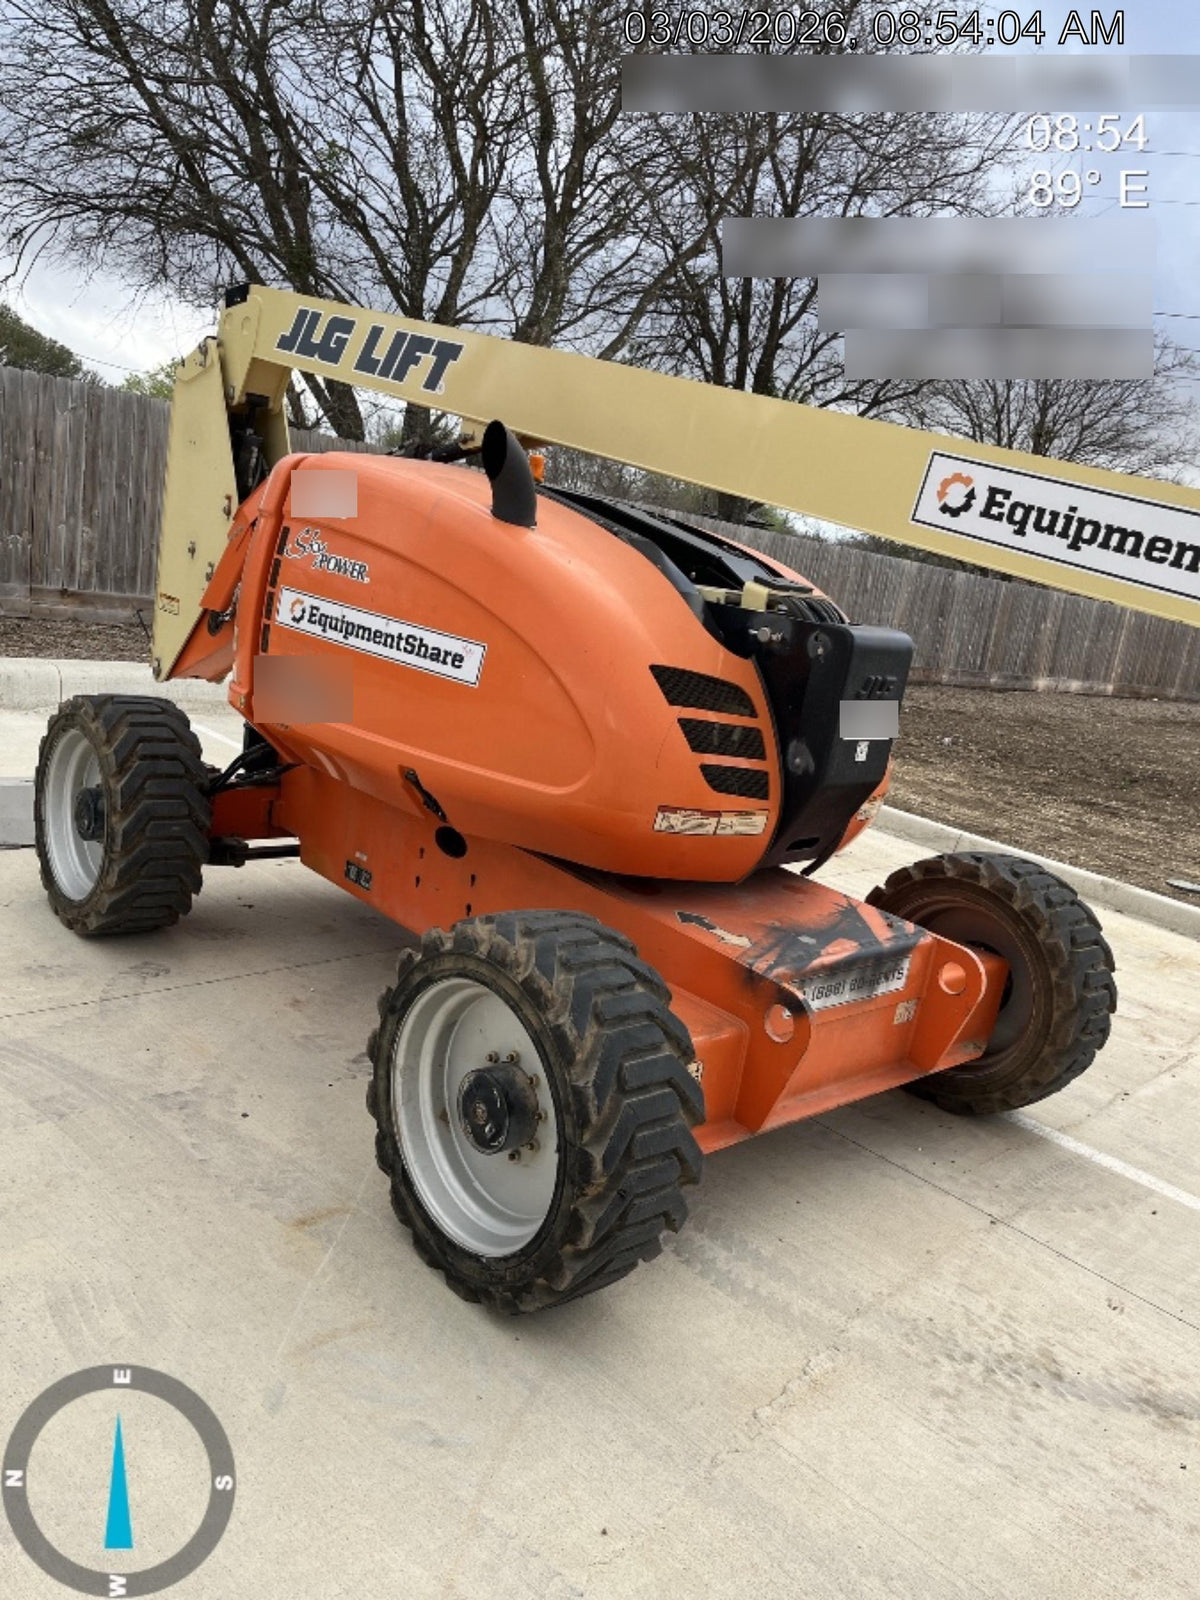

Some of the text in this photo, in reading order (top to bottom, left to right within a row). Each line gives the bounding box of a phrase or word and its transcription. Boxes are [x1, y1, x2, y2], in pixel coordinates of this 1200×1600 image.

[275, 306, 464, 392] JLG LIFT
[312, 551, 368, 583] POWER
[307, 605, 465, 669] EquipmentShare
